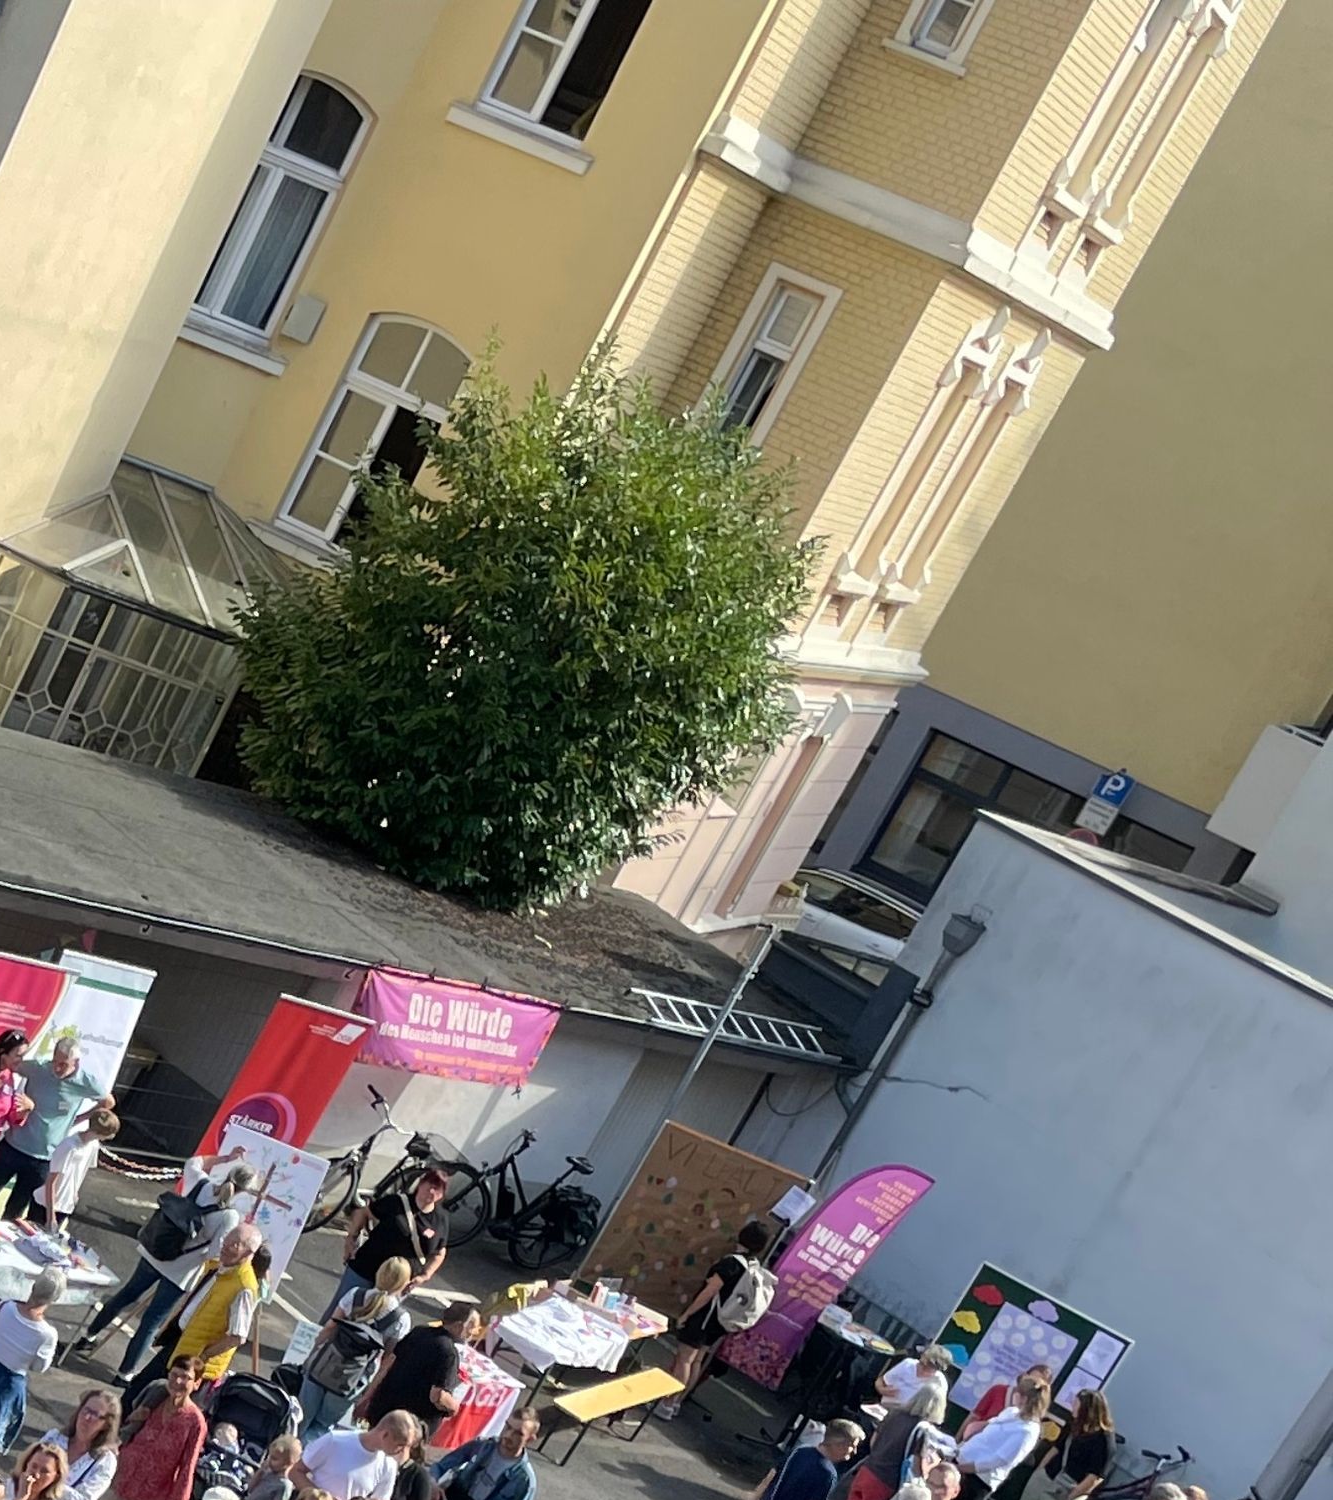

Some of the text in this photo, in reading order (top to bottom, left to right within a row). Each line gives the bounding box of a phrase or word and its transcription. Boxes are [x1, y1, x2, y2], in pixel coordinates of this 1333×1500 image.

[1100, 774, 1126, 796] P
[408, 993, 513, 1040] Die Würde
[379, 1022, 400, 1039] des
[400, 1024, 451, 1048] Menschen
[451, 1033, 466, 1049] ist
[229, 1114, 274, 1134] STÄRKER
[849, 1222, 881, 1249] Die
